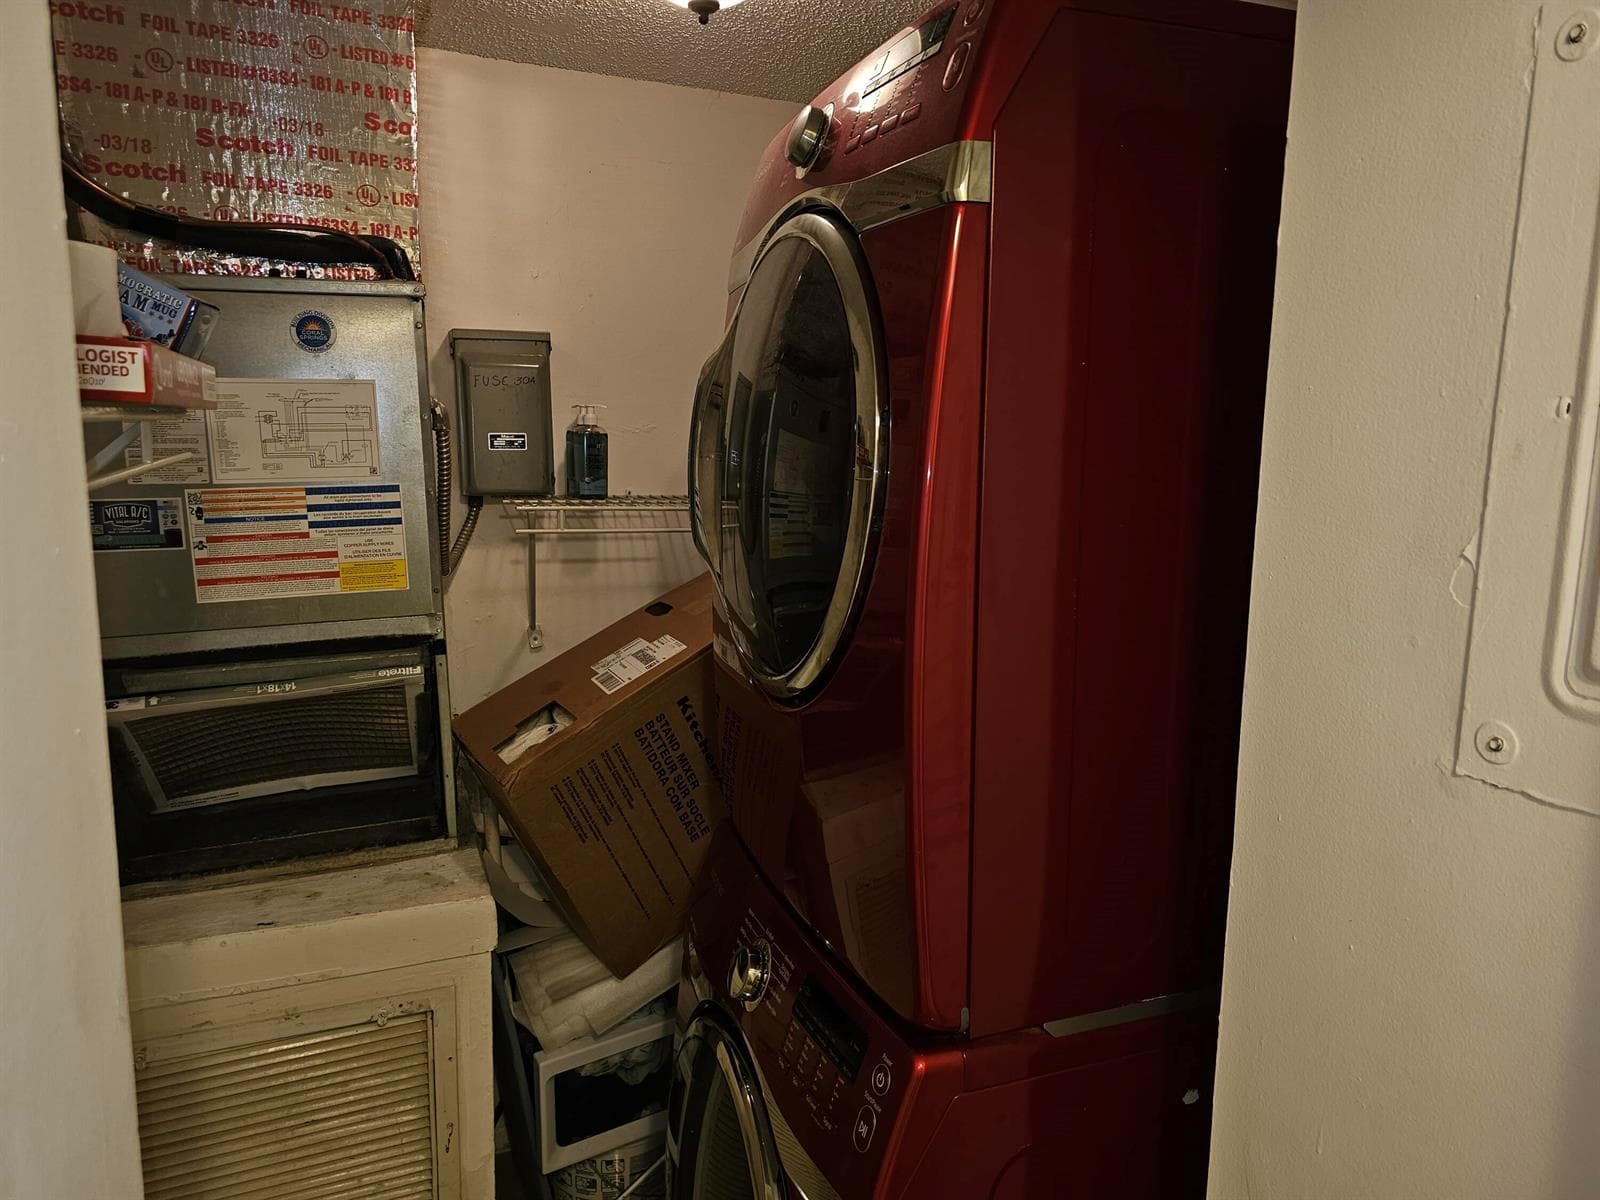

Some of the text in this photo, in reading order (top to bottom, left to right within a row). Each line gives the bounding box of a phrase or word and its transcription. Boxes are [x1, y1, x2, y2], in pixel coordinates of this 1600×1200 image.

[331, 5, 373, 25] TAPE
[71, 42, 118, 62] 3326
[140, 13, 181, 34] FOIL
[185, 20, 231, 41] TAPE
[236, 29, 280, 49] 3326
[341, 44, 388, 65] LISTED
[166, 92, 178, 108] &
[182, 94, 207, 112] 181
[196, 127, 294, 158] Scotch
[307, 144, 343, 163] FOIL
[348, 150, 388, 169] TAPE
[81, 152, 187, 184] Scotch
[202, 170, 240, 189] FOIL
[245, 177, 289, 195] TAPE
[294, 181, 333, 199] 3326
[150, 300, 178, 319] MUG
[473, 374, 509, 388] FUSE
[105, 505, 148, 519] VITAL A/C
[656, 713, 699, 790] STAND MIXER
[634, 728, 700, 842] BATIDORA CON BASE
[645, 720, 711, 836] BATTEUR SUR SOCLE
